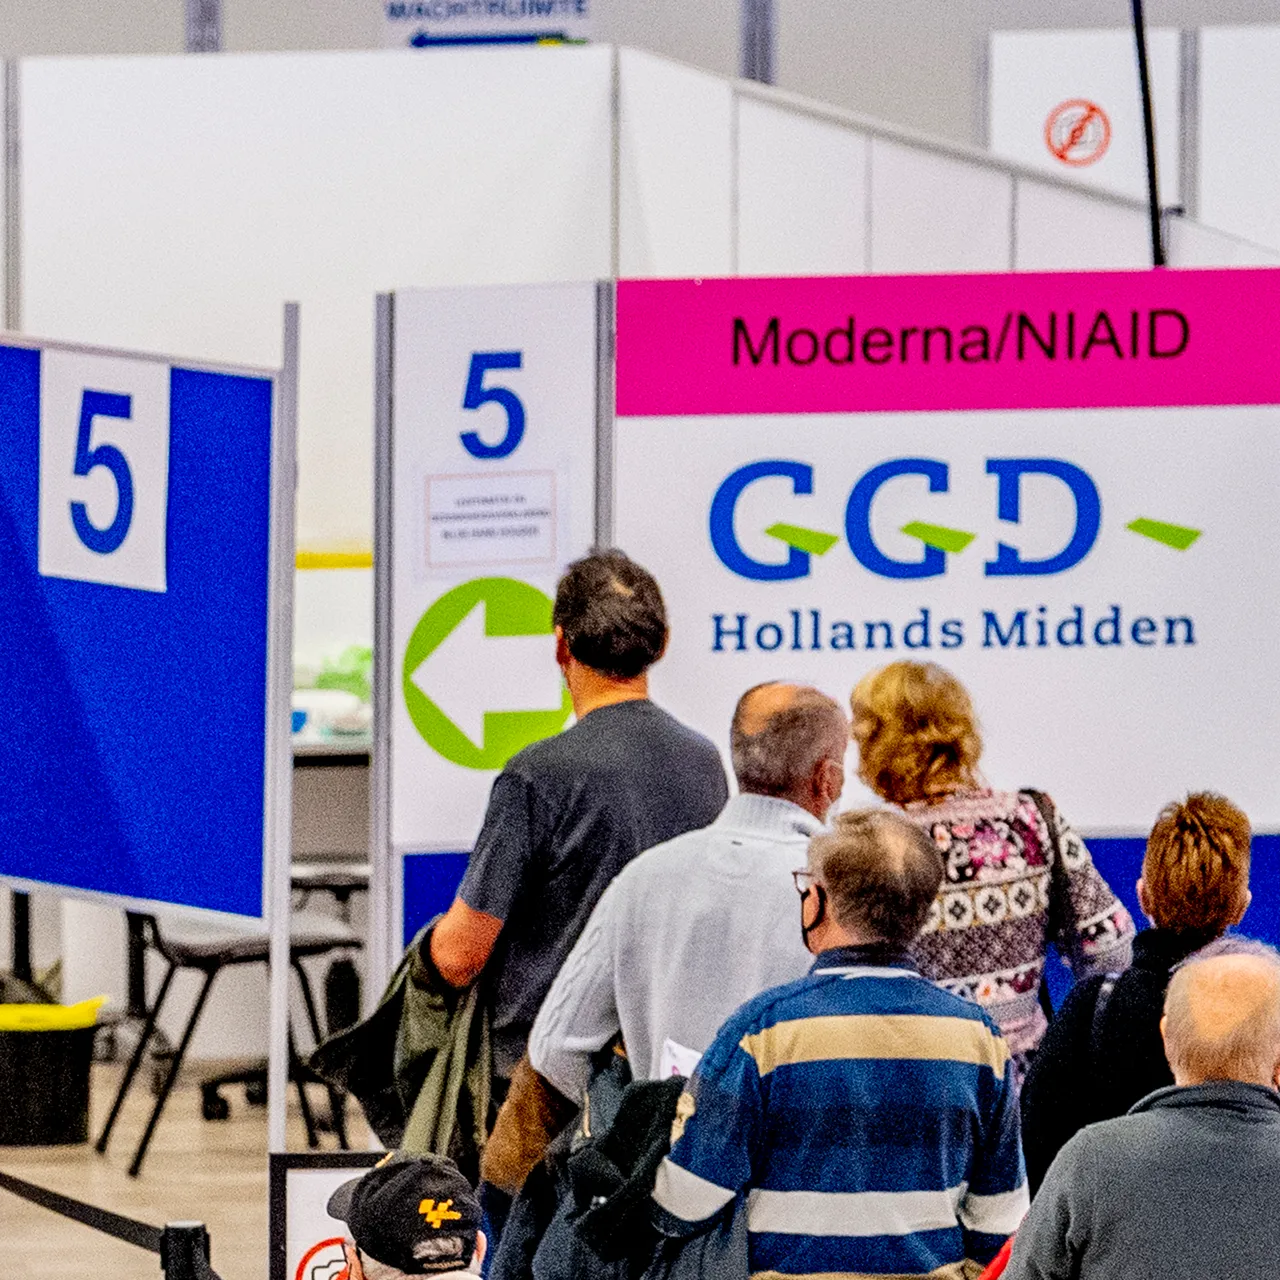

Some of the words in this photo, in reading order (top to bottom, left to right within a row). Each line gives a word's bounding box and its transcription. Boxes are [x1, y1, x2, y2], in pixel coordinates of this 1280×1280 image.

[732, 308, 1191, 367] Moderna/NIAID
[459, 351, 526, 460] 5
[70, 388, 134, 555] 5
[708, 457, 1102, 582] GGD
[711, 608, 964, 652] Hollands
[982, 605, 1196, 649] Midden
